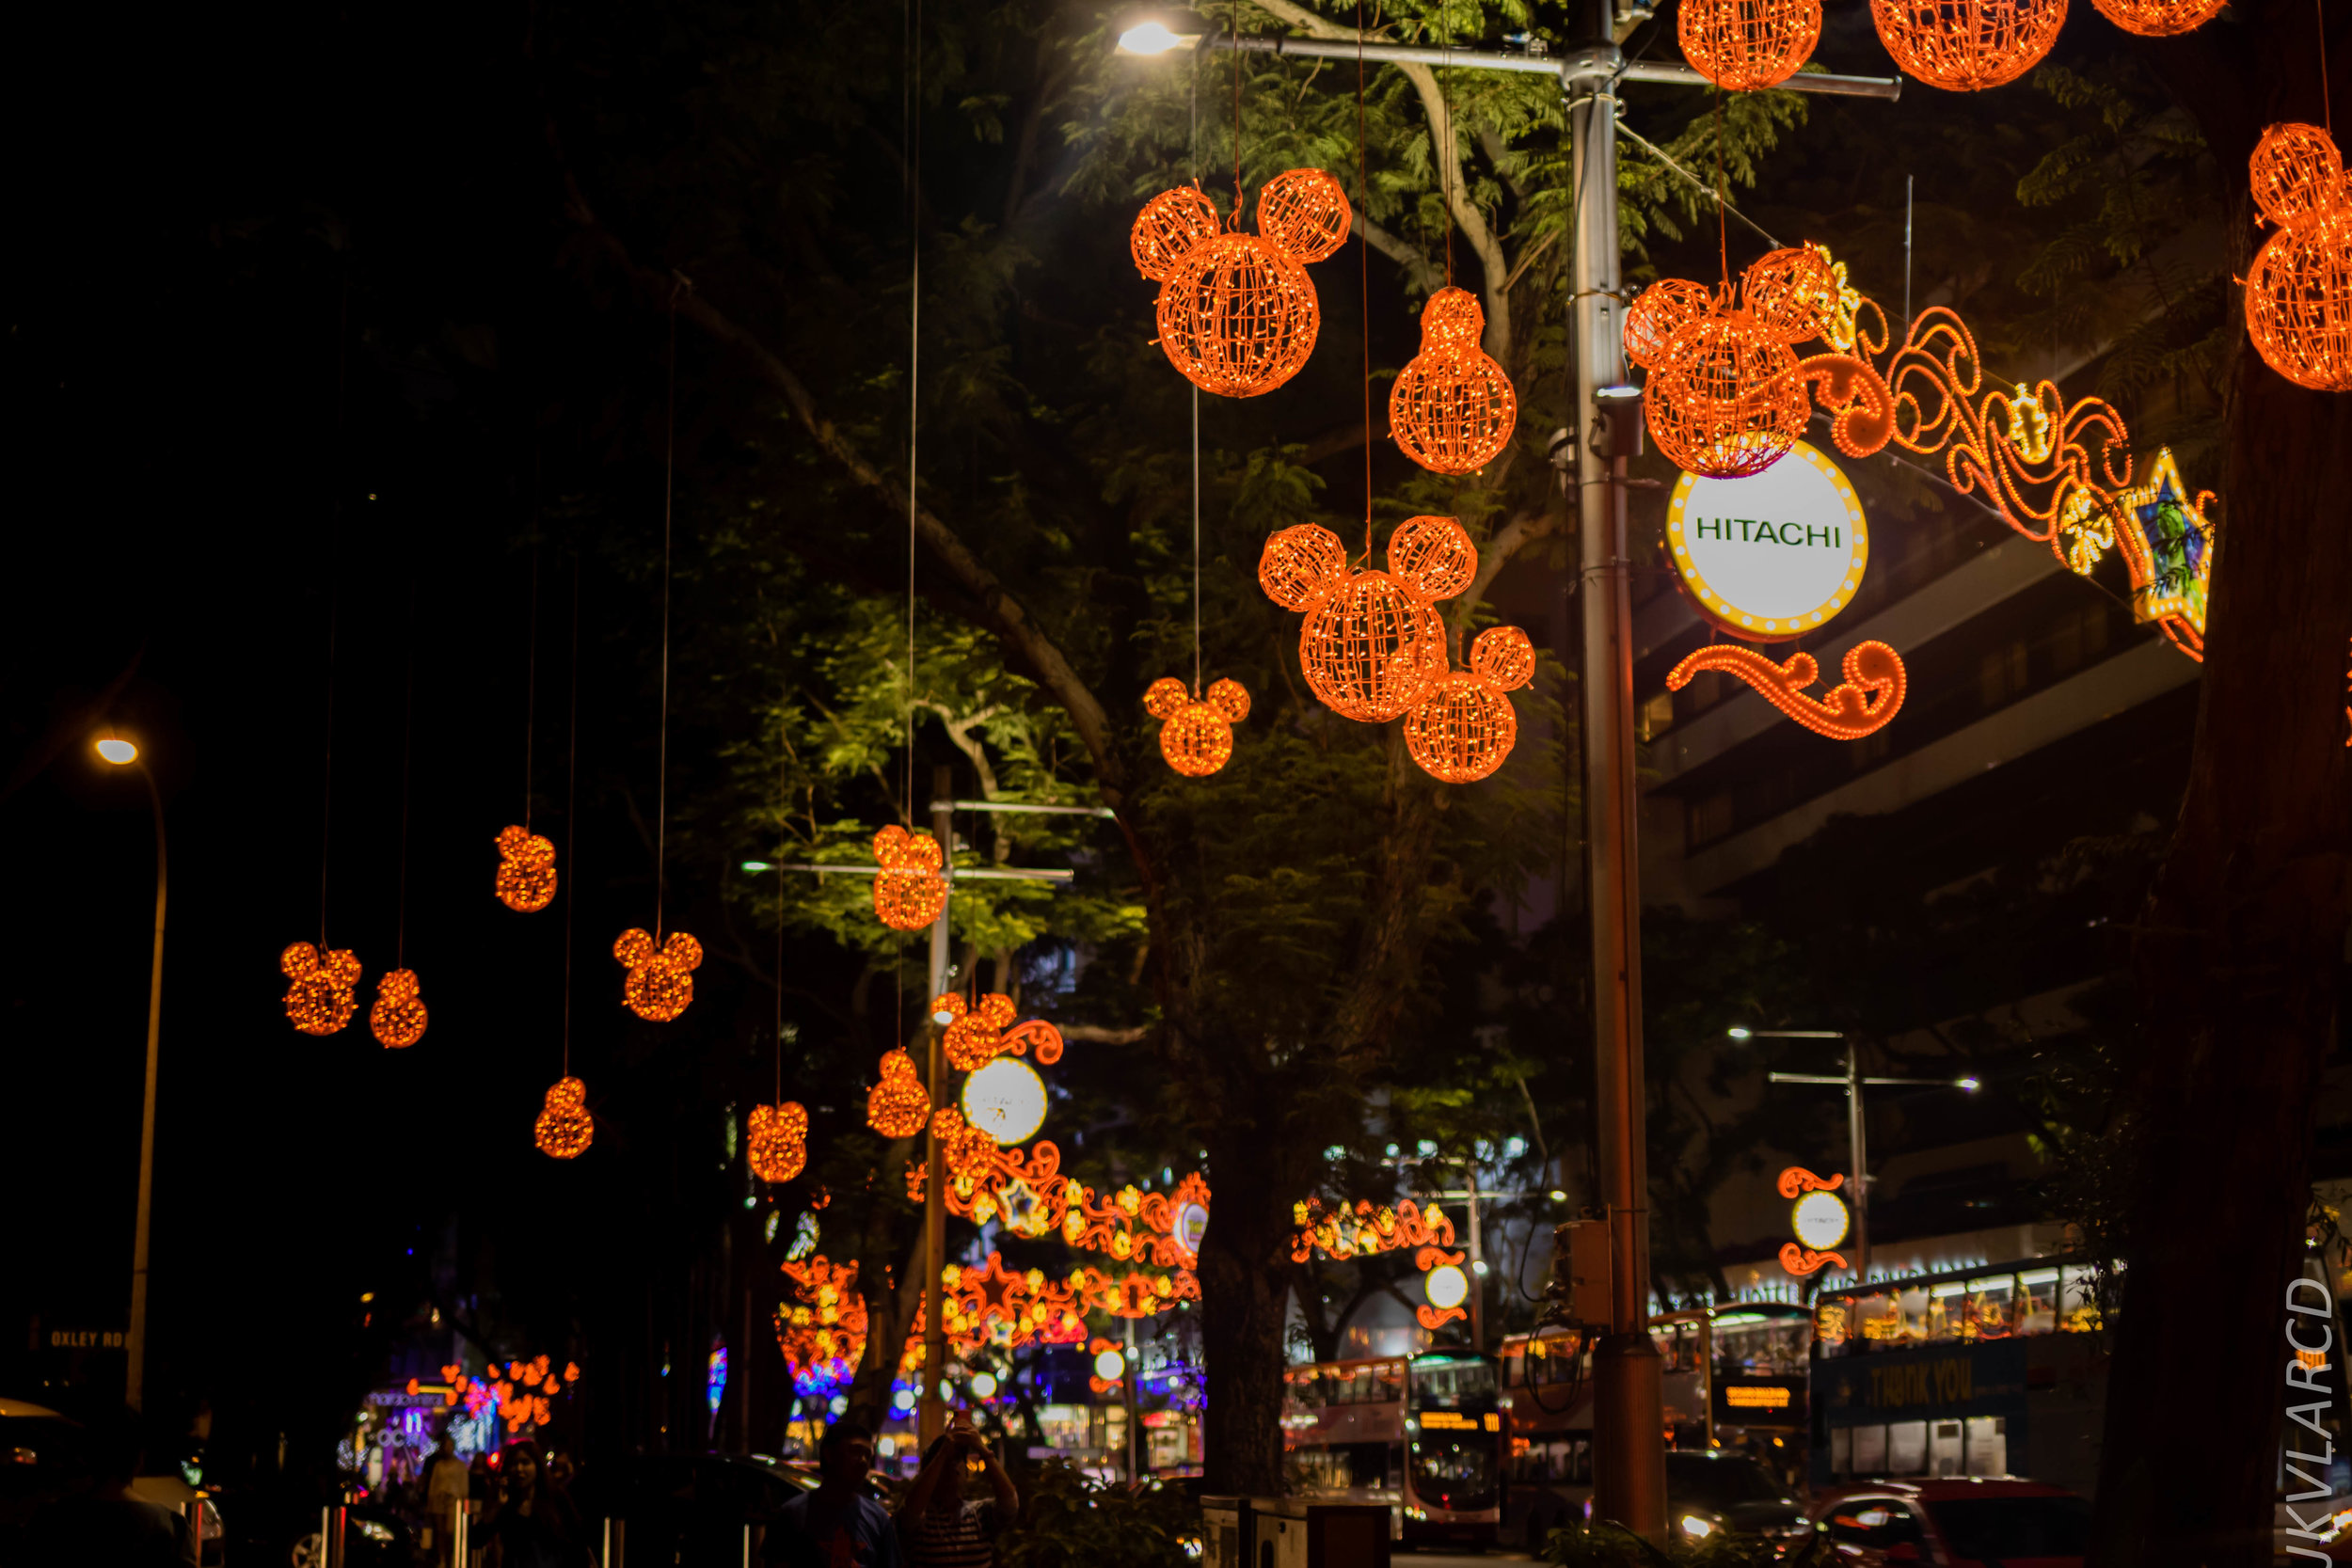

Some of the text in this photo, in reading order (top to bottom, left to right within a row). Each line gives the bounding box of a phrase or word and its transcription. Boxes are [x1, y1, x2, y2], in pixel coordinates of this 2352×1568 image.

[1697, 517, 1841, 548] HITACHI
[52, 1331, 122, 1348] OXLEY RD
[1933, 1357, 1973, 1405] YOU
